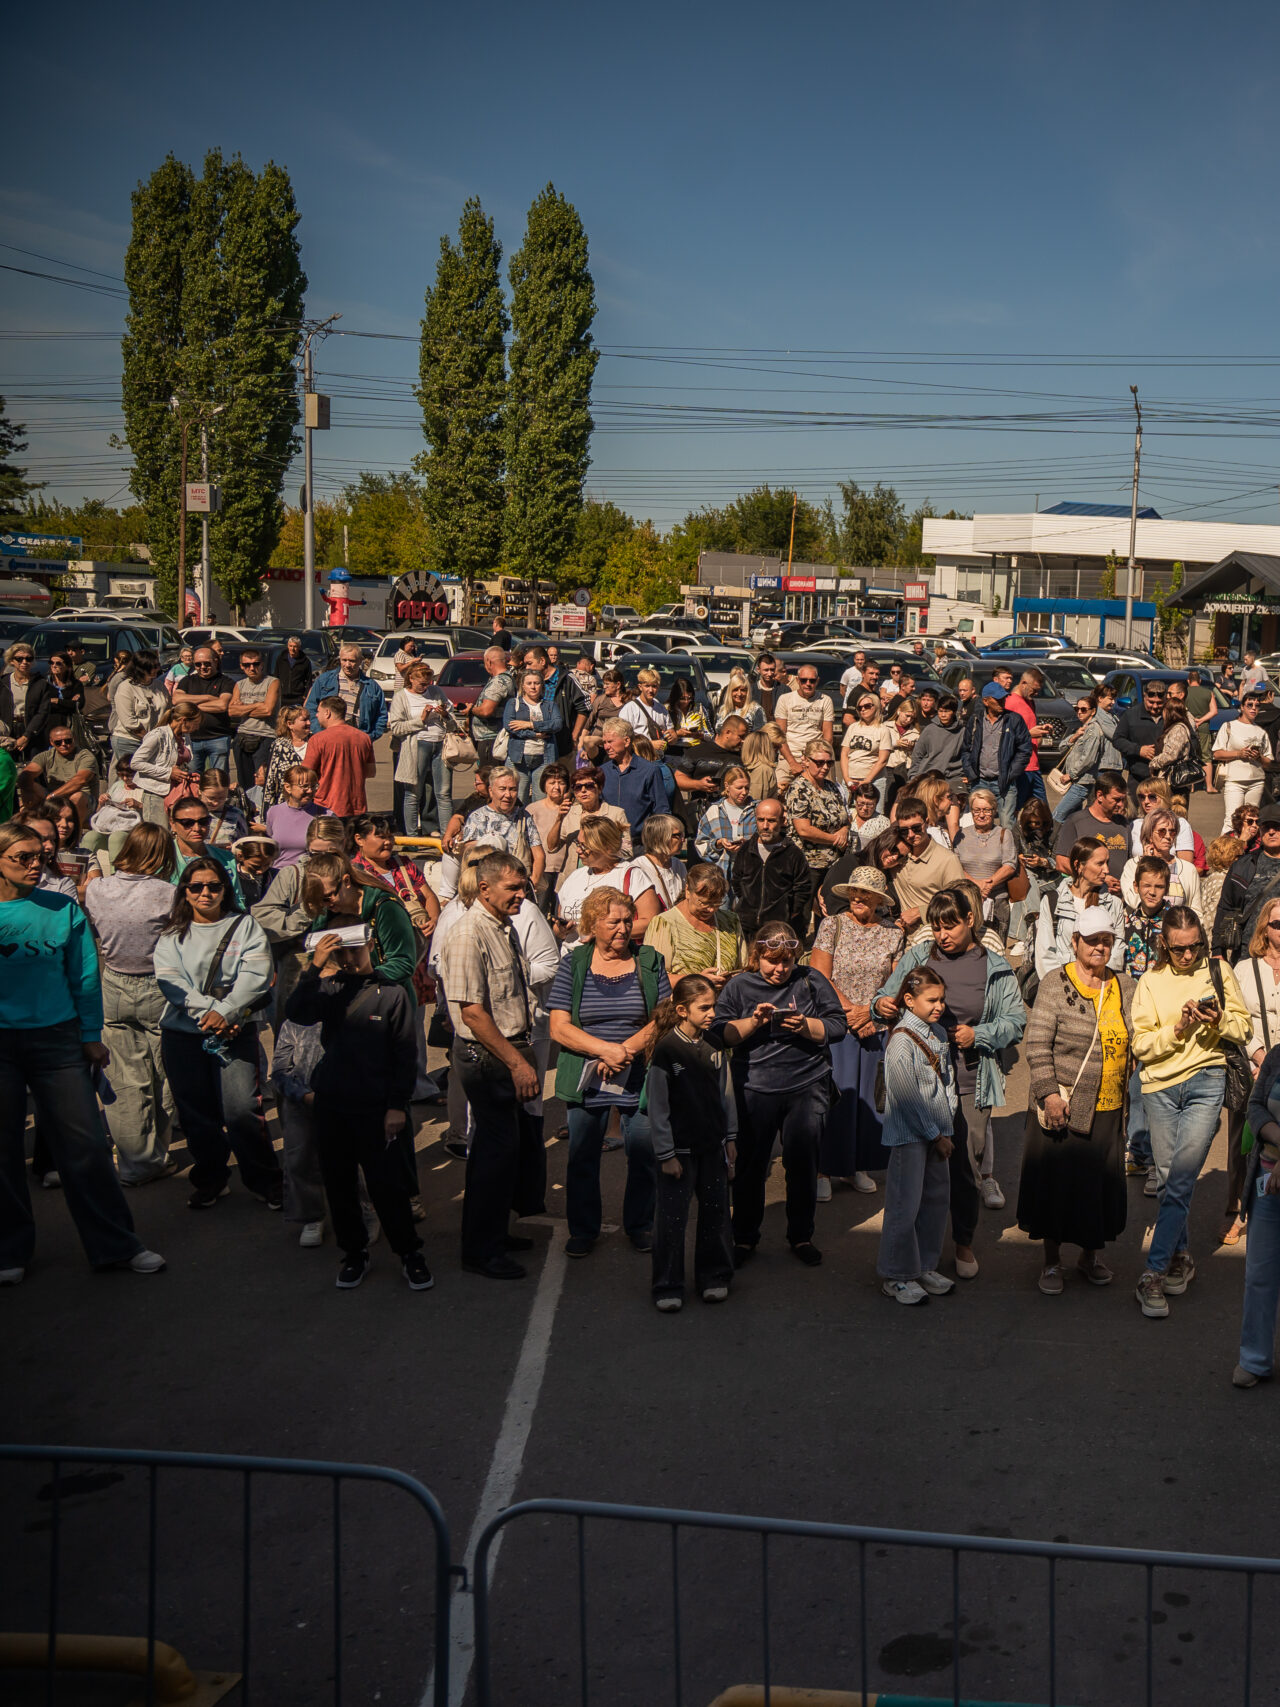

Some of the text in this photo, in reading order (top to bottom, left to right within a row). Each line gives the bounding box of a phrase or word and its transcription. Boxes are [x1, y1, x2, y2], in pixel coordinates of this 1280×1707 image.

[757, 577, 777, 587] ШИНЫ
[905, 585, 926, 598] ШИНЫ
[397, 600, 448, 621] АВТО
[1203, 602, 1255, 615] ДОМОЦЕНТР
